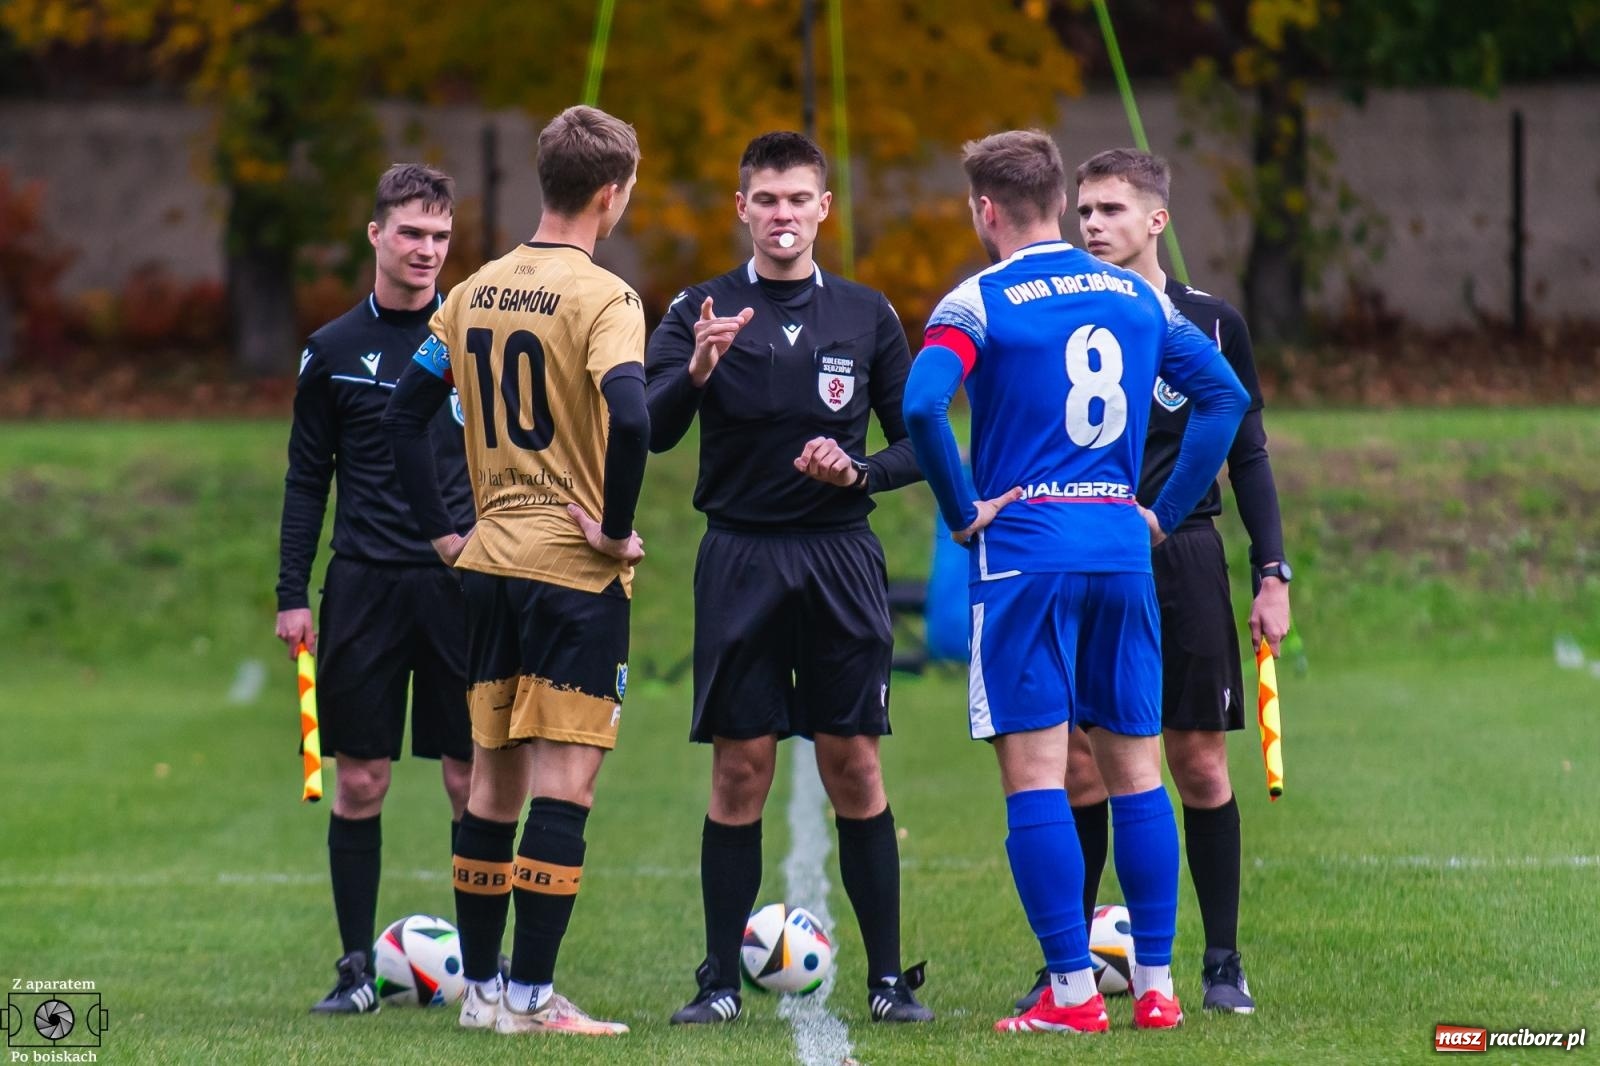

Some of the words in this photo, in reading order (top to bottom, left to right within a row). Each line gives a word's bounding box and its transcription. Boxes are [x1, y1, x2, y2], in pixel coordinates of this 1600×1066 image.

[470, 285, 498, 310] LKS
[498, 286, 561, 316] GAMÓW
[1003, 279, 1053, 305] UNIA
[1050, 270, 1138, 298] RACIBÓRZ
[466, 327, 556, 451] 10
[1065, 324, 1128, 449] 8
[488, 467, 504, 486] lat
[505, 467, 573, 491] Tradycji
